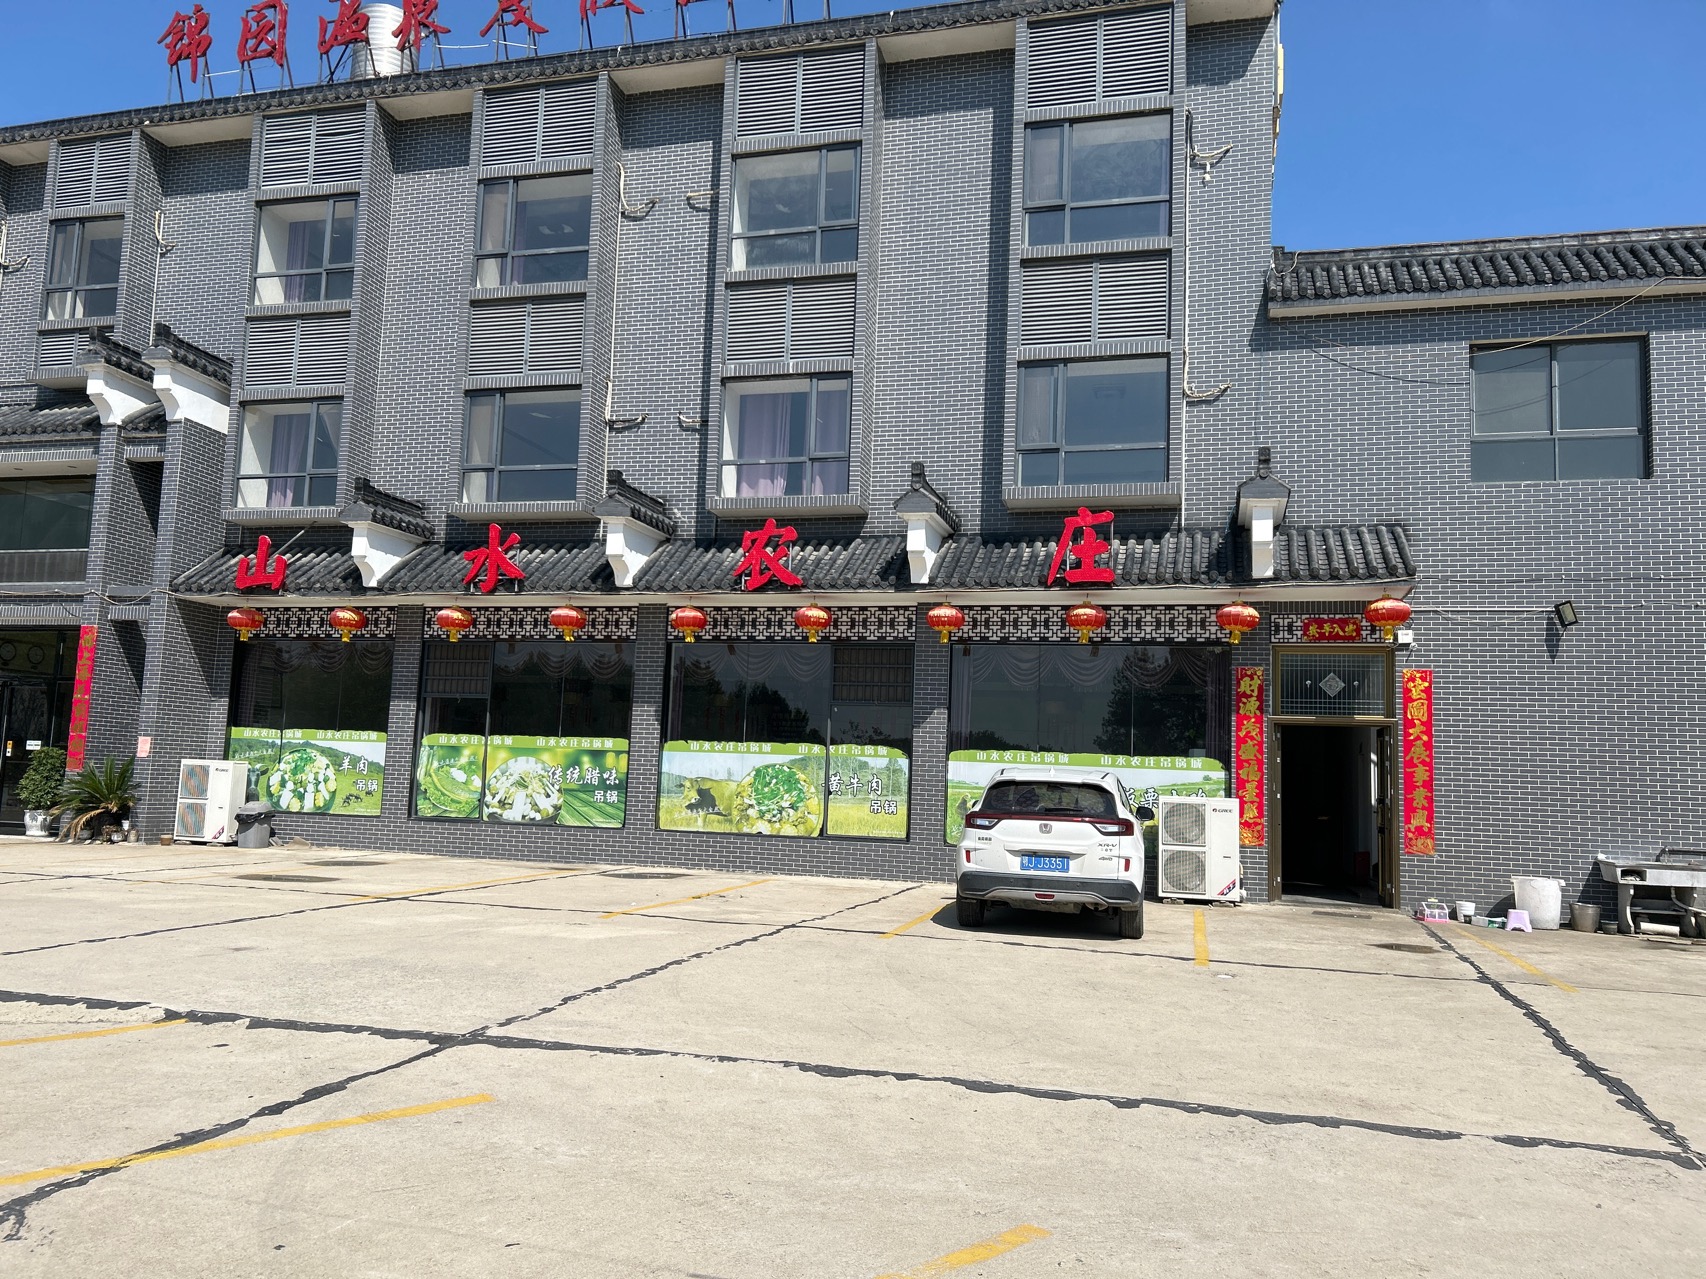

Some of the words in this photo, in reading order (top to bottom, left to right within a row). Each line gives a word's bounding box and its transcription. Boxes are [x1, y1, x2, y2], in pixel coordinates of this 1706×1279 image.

[235, 506, 1115, 592] 山水农庄
[977, 750, 1069, 764] 山水农庄吊锅城
[1101, 755, 1202, 768] 山水农庄吊锅城
[339, 754, 368, 776] 羊肉
[548, 764, 619, 786] 传统腊味
[356, 779, 378, 792] 吊锅
[821, 772, 882, 796] 黄牛肉
[594, 790, 618, 803] 吊锅
[870, 800, 898, 815] 吊锅
